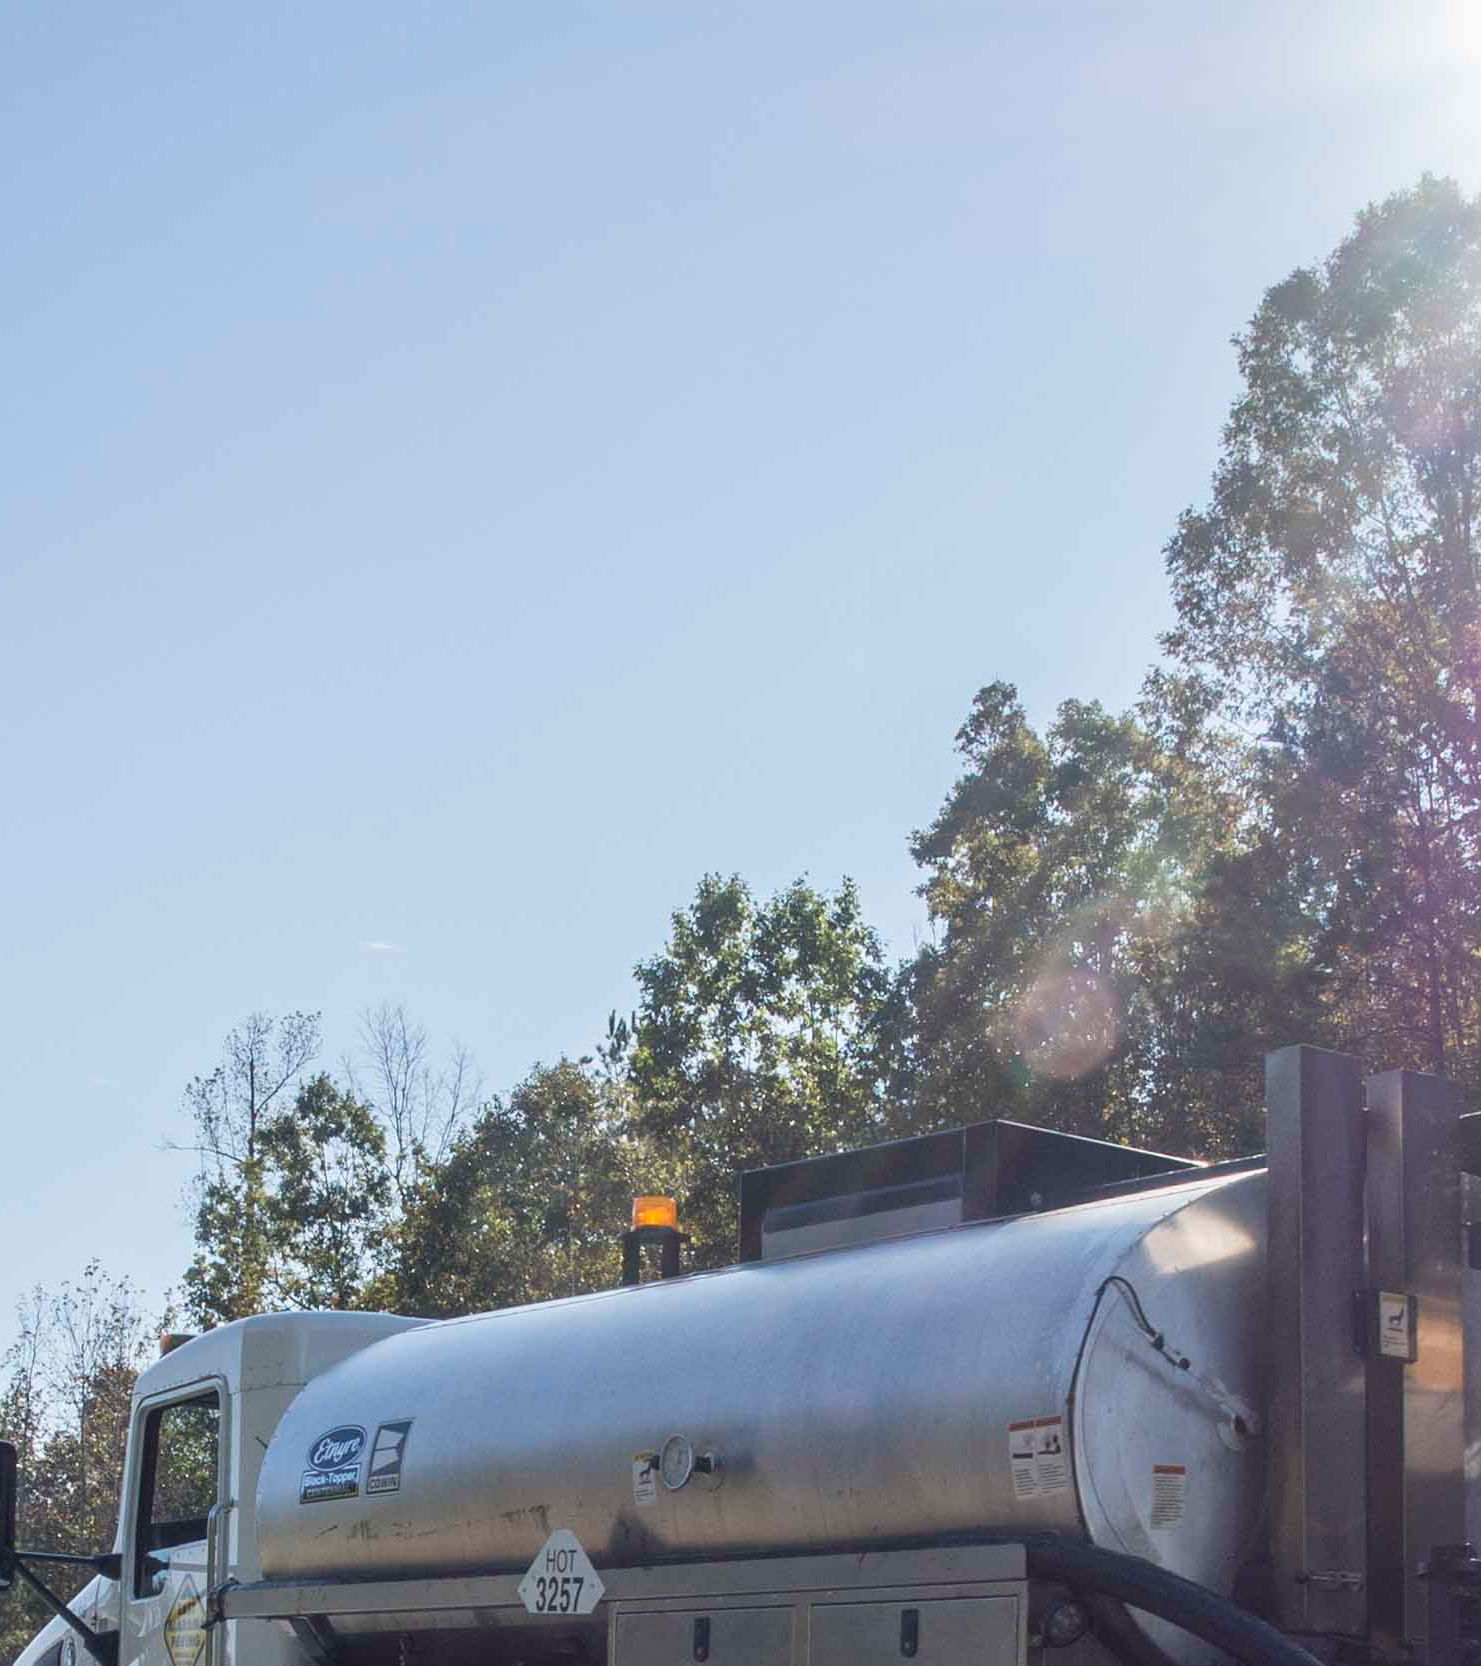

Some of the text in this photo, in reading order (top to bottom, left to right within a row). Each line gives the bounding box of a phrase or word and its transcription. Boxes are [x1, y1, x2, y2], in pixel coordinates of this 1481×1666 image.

[313, 1438, 360, 1464] Etnyre
[546, 1549, 577, 1573] HOT
[535, 1576, 584, 1613] 3257
